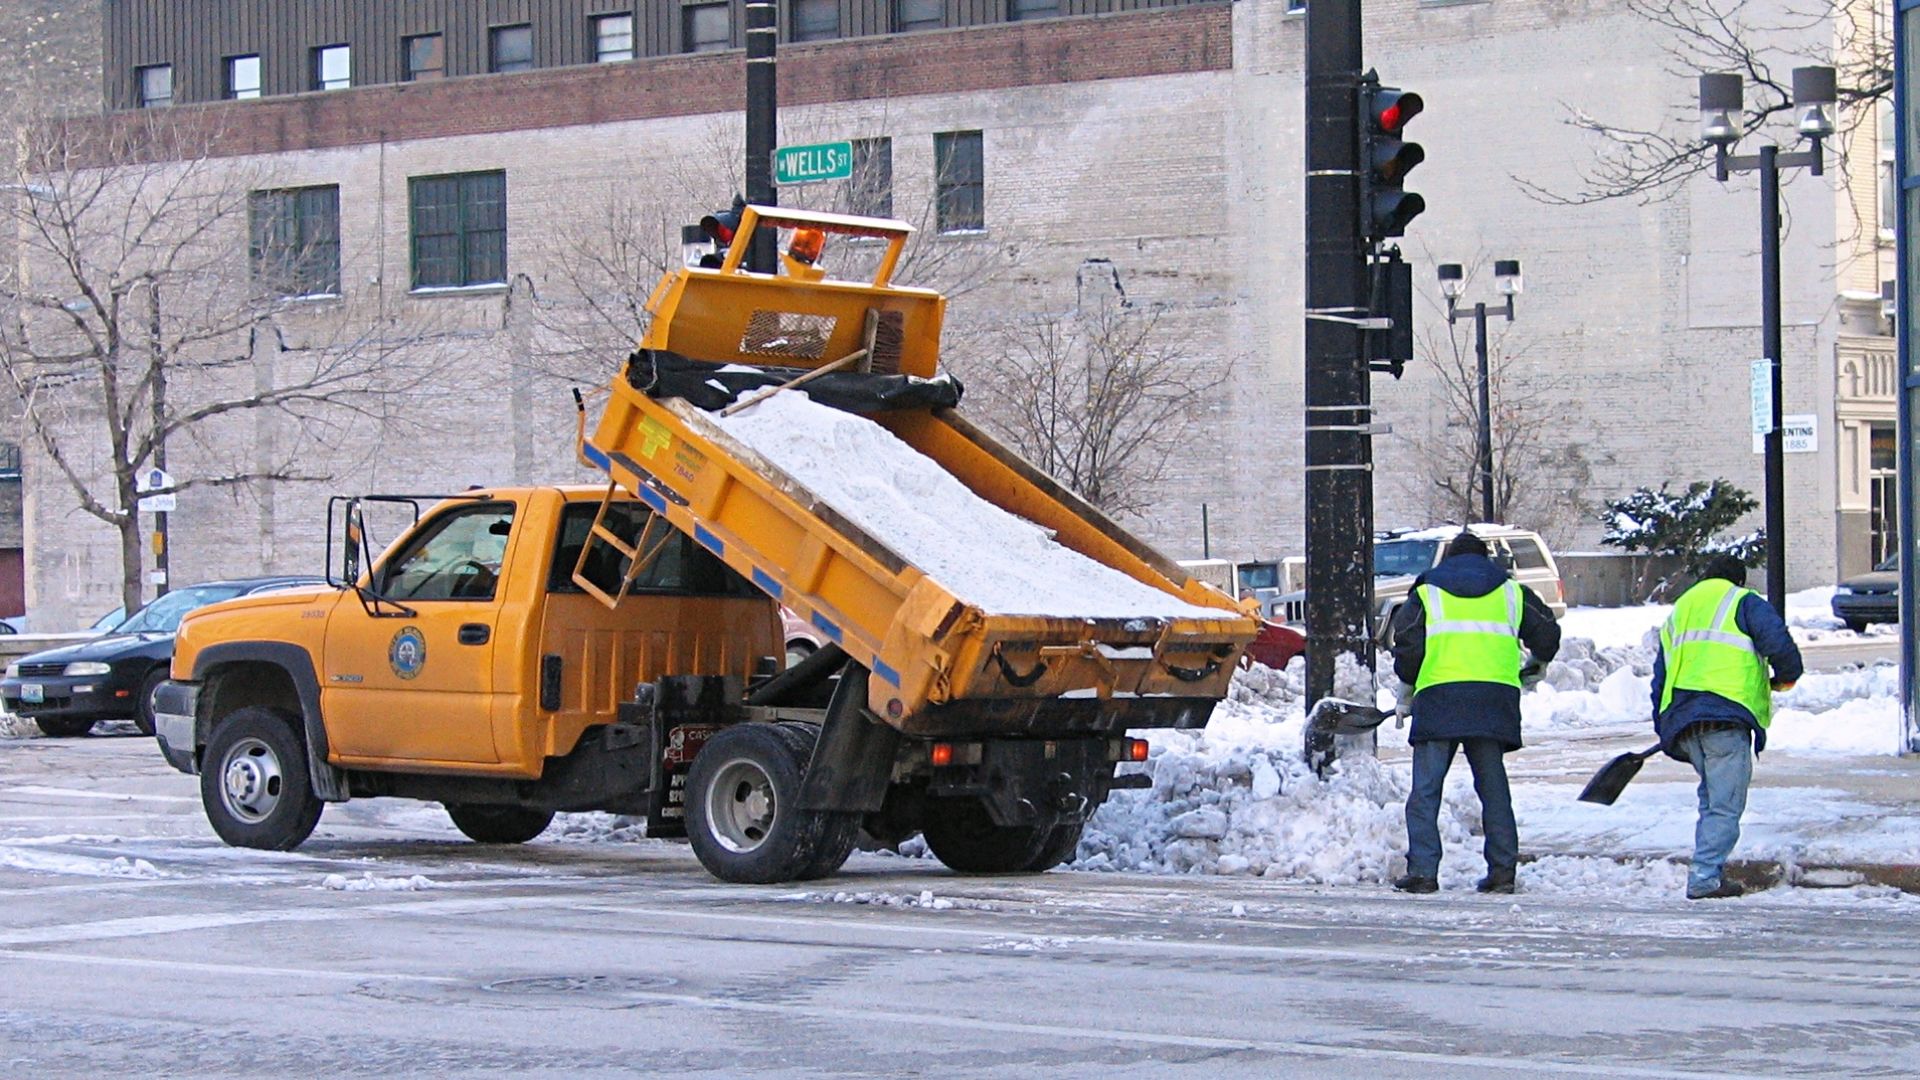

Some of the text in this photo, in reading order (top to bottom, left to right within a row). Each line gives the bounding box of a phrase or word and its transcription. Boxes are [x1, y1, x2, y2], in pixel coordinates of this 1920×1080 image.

[779, 149, 848, 177] W WELLS ST
[1782, 427, 1814, 437] ENTING
